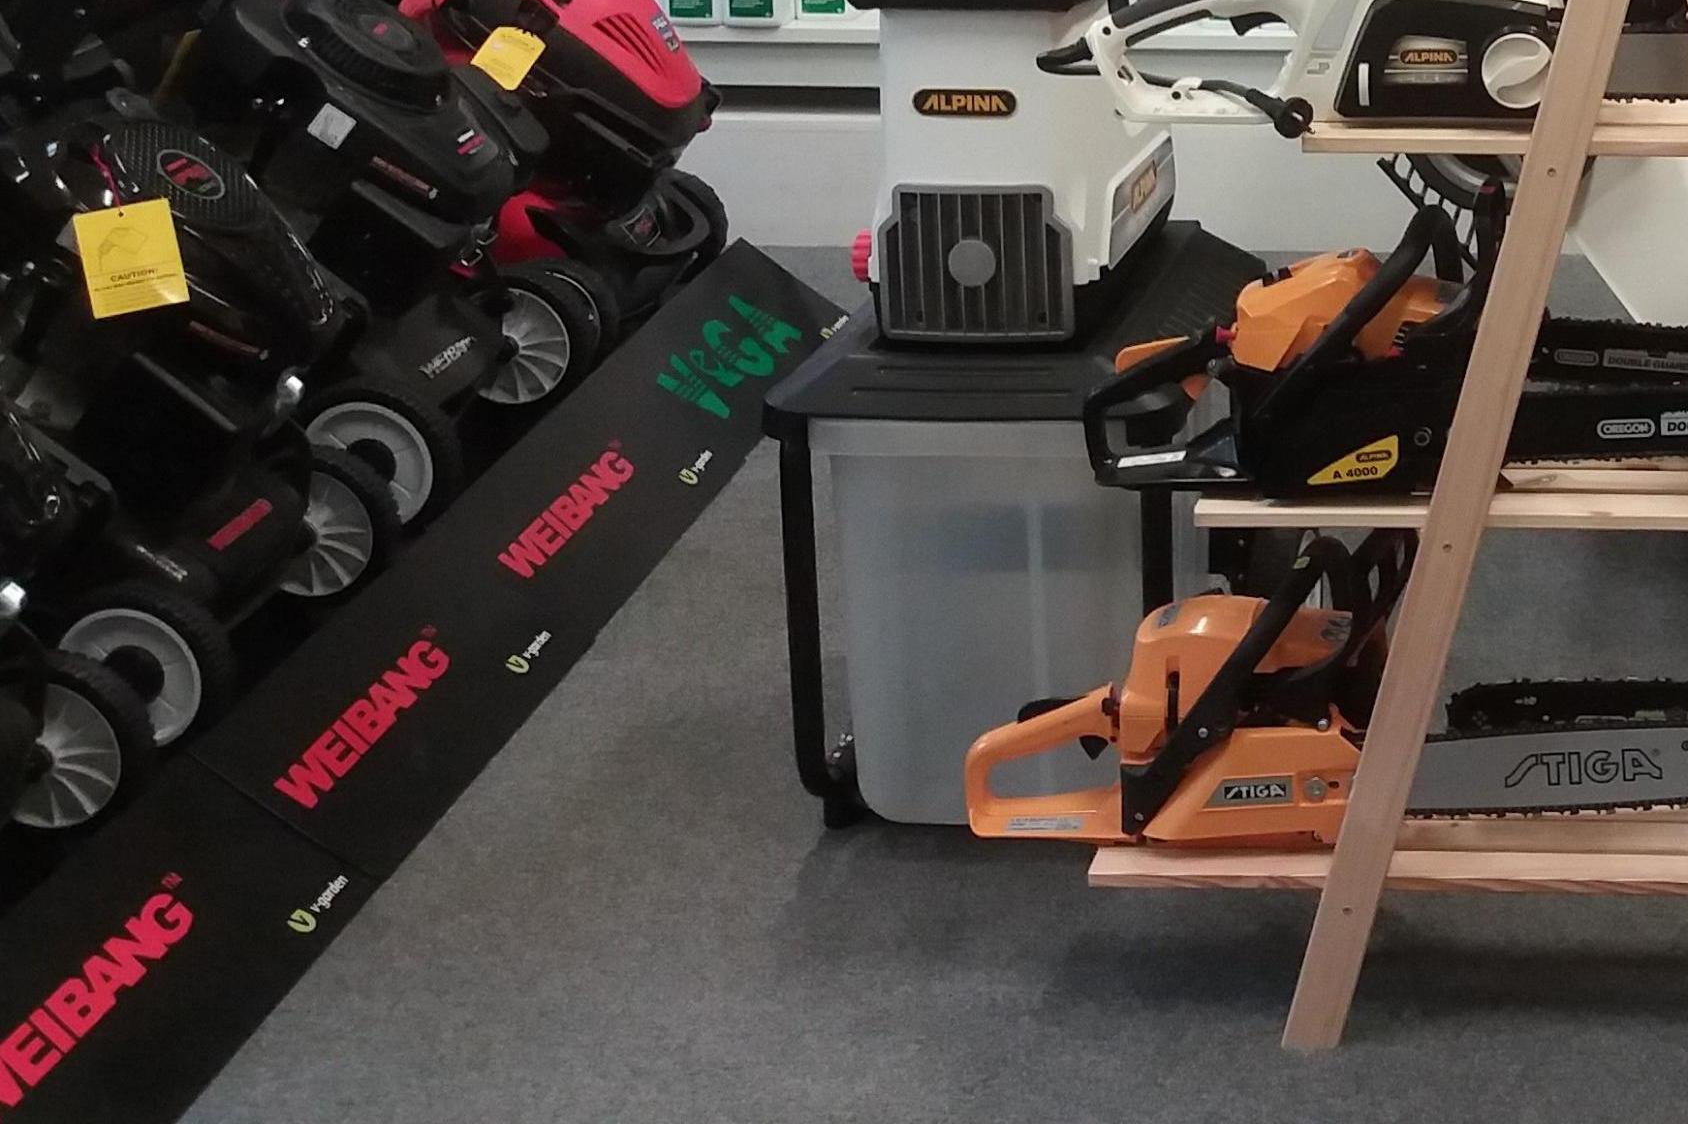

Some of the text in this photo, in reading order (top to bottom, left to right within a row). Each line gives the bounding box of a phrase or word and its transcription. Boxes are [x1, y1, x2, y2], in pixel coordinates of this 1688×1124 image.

[1404, 51, 1453, 63] ALPINA
[921, 94, 1009, 113] ALPINA
[1332, 465, 1379, 480] A 4000
[497, 449, 635, 579] WEIBANG
[273, 640, 450, 810] WEIBANG
[1505, 748, 1663, 788] STIGA
[1226, 784, 1285, 799] STIGA
[309, 874, 348, 912] v-garden
